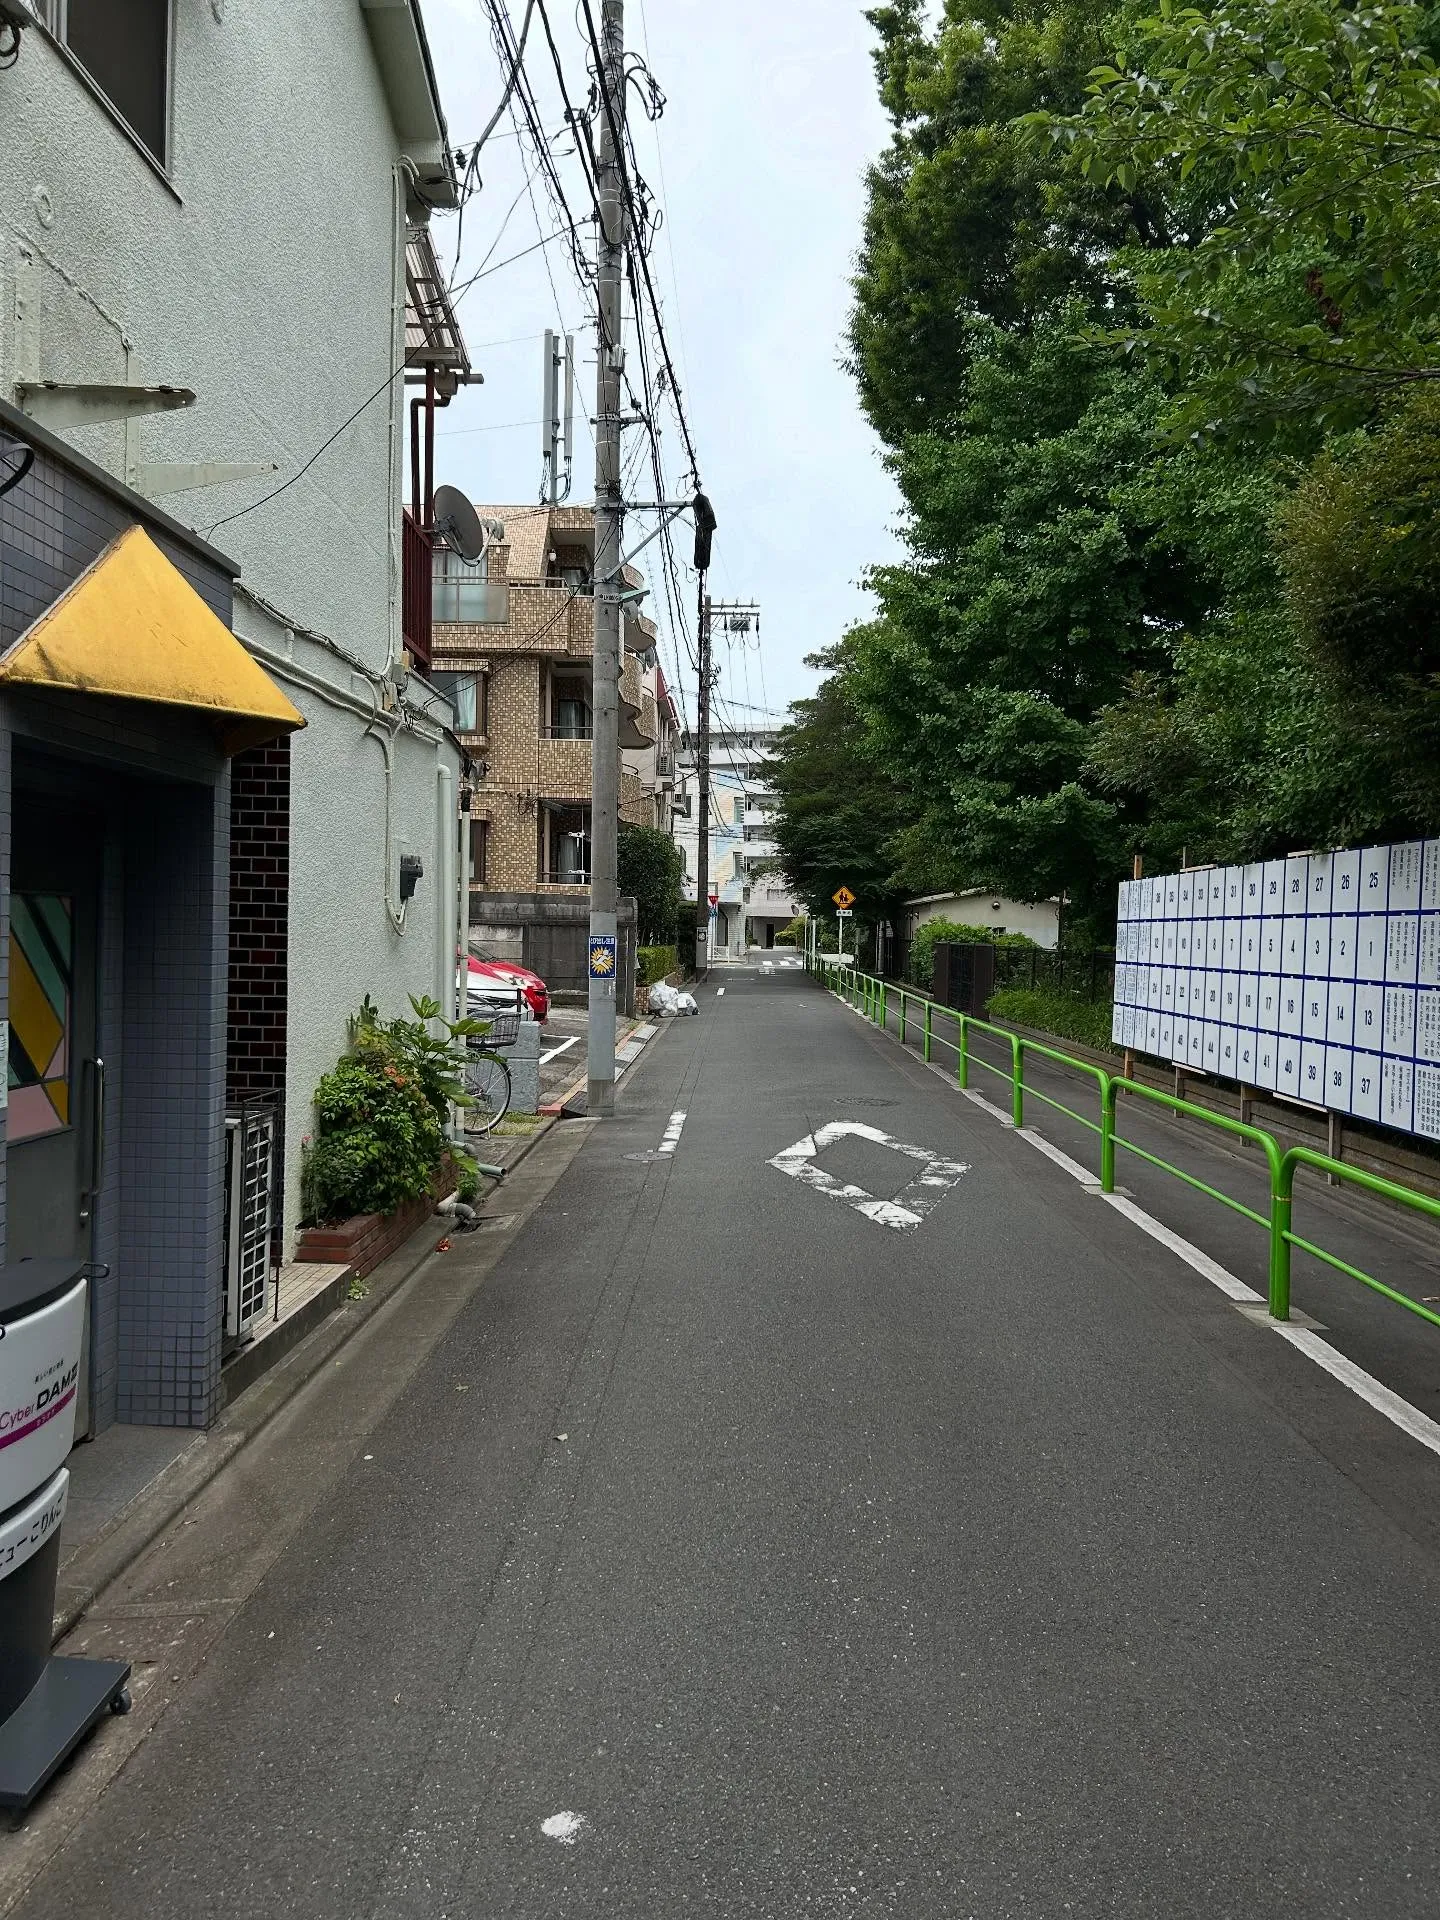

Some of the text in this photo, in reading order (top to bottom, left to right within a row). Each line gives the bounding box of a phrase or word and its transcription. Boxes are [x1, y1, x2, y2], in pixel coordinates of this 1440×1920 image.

[1292, 879, 1299, 893] 28
[1315, 877, 1323, 891] 27
[1341, 875, 1350, 890] 26
[1369, 872, 1378, 888] 25
[1213, 887, 1219, 899] 32
[1231, 885, 1237, 898] 31
[1249, 883, 1256, 896] 30
[1270, 881, 1276, 894] 29
[1197, 938, 1201, 950] 9
[1213, 938, 1216, 951] 8
[1230, 938, 1234, 951] 7
[1249, 939, 1252, 952] 6
[1269, 939, 1273, 952] 5
[1290, 940, 1295, 953] 4
[1315, 940, 1319, 955] 3
[1341, 940, 1345, 956] 2
[1369, 941, 1373, 957] 1
[1179, 986, 1185, 998] 22
[1195, 988, 1200, 1000] 21
[1210, 990, 1216, 1002] 20
[1227, 992, 1232, 1005] 19
[1266, 997, 1272, 1010] 17
[1288, 999, 1294, 1014] 16
[1312, 1003, 1318, 1017] 15
[1337, 1006, 1344, 1020] 14
[1365, 1010, 1372, 1026] 13
[1225, 1046, 1231, 1058] 43
[1243, 1050, 1249, 1063] 42
[1263, 1055, 1270, 1068] 41
[1285, 1060, 1292, 1074] 40
[1308, 1065, 1316, 1080] 39
[1333, 1071, 1342, 1087] 38
[1361, 1077, 1370, 1094] 37
